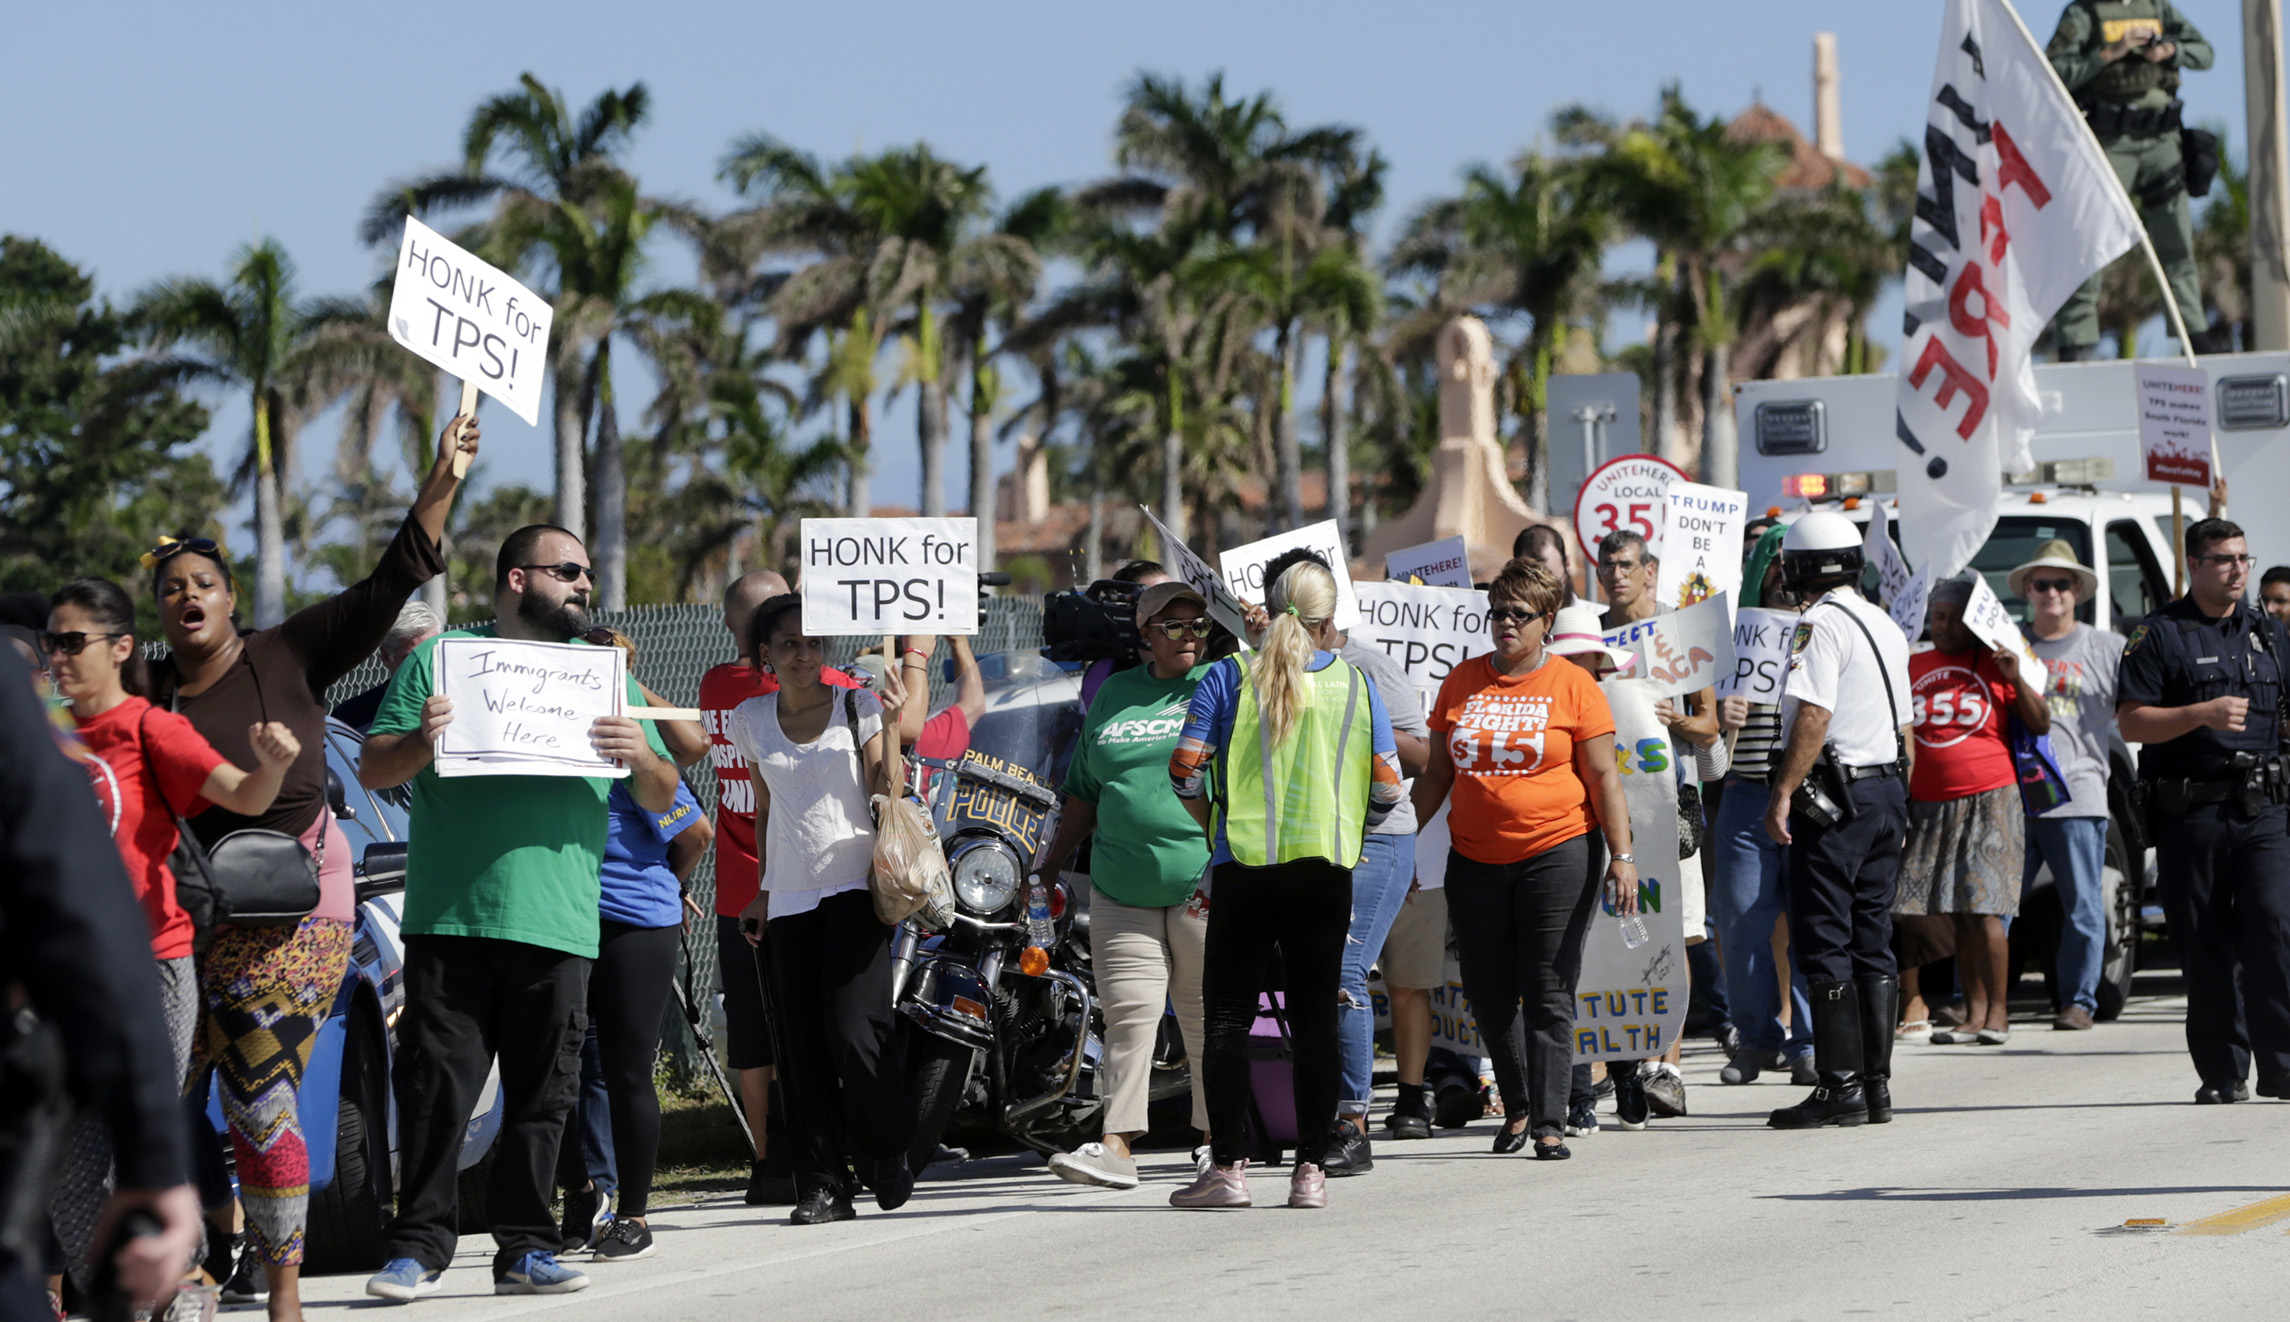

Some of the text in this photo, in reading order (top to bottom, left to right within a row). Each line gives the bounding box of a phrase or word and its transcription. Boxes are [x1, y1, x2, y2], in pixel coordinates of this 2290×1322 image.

[408, 239, 542, 344] HONK for
[426, 296, 519, 391] TPS!
[1614, 486, 1663, 499] LOCAL
[1670, 494, 1739, 515] TRUMP
[1679, 515, 1727, 535] DON'T
[811, 534, 969, 566] HONK for
[1692, 538, 1711, 552] BE
[1695, 556, 1706, 569] A
[1229, 563, 1265, 595] HO
[837, 578, 945, 621] TPS!
[1359, 599, 1489, 634] HONK for
[468, 650, 602, 695] Immigrants
[1325, 680, 1349, 689] LATIN
[483, 688, 580, 721] Welcome
[1464, 700, 1550, 718] FLORIDA
[1912, 692, 1983, 727] 355
[503, 721, 561, 749] Here
[1098, 717, 1186, 740] AFSCM
[1108, 737, 1131, 745] Make
[1132, 734, 1167, 743] America
[1452, 728, 1538, 770] $15
[963, 749, 1055, 791] PALM BEACH
[945, 776, 1046, 855] POLICE
[1574, 1023, 1660, 1055] ALTH
